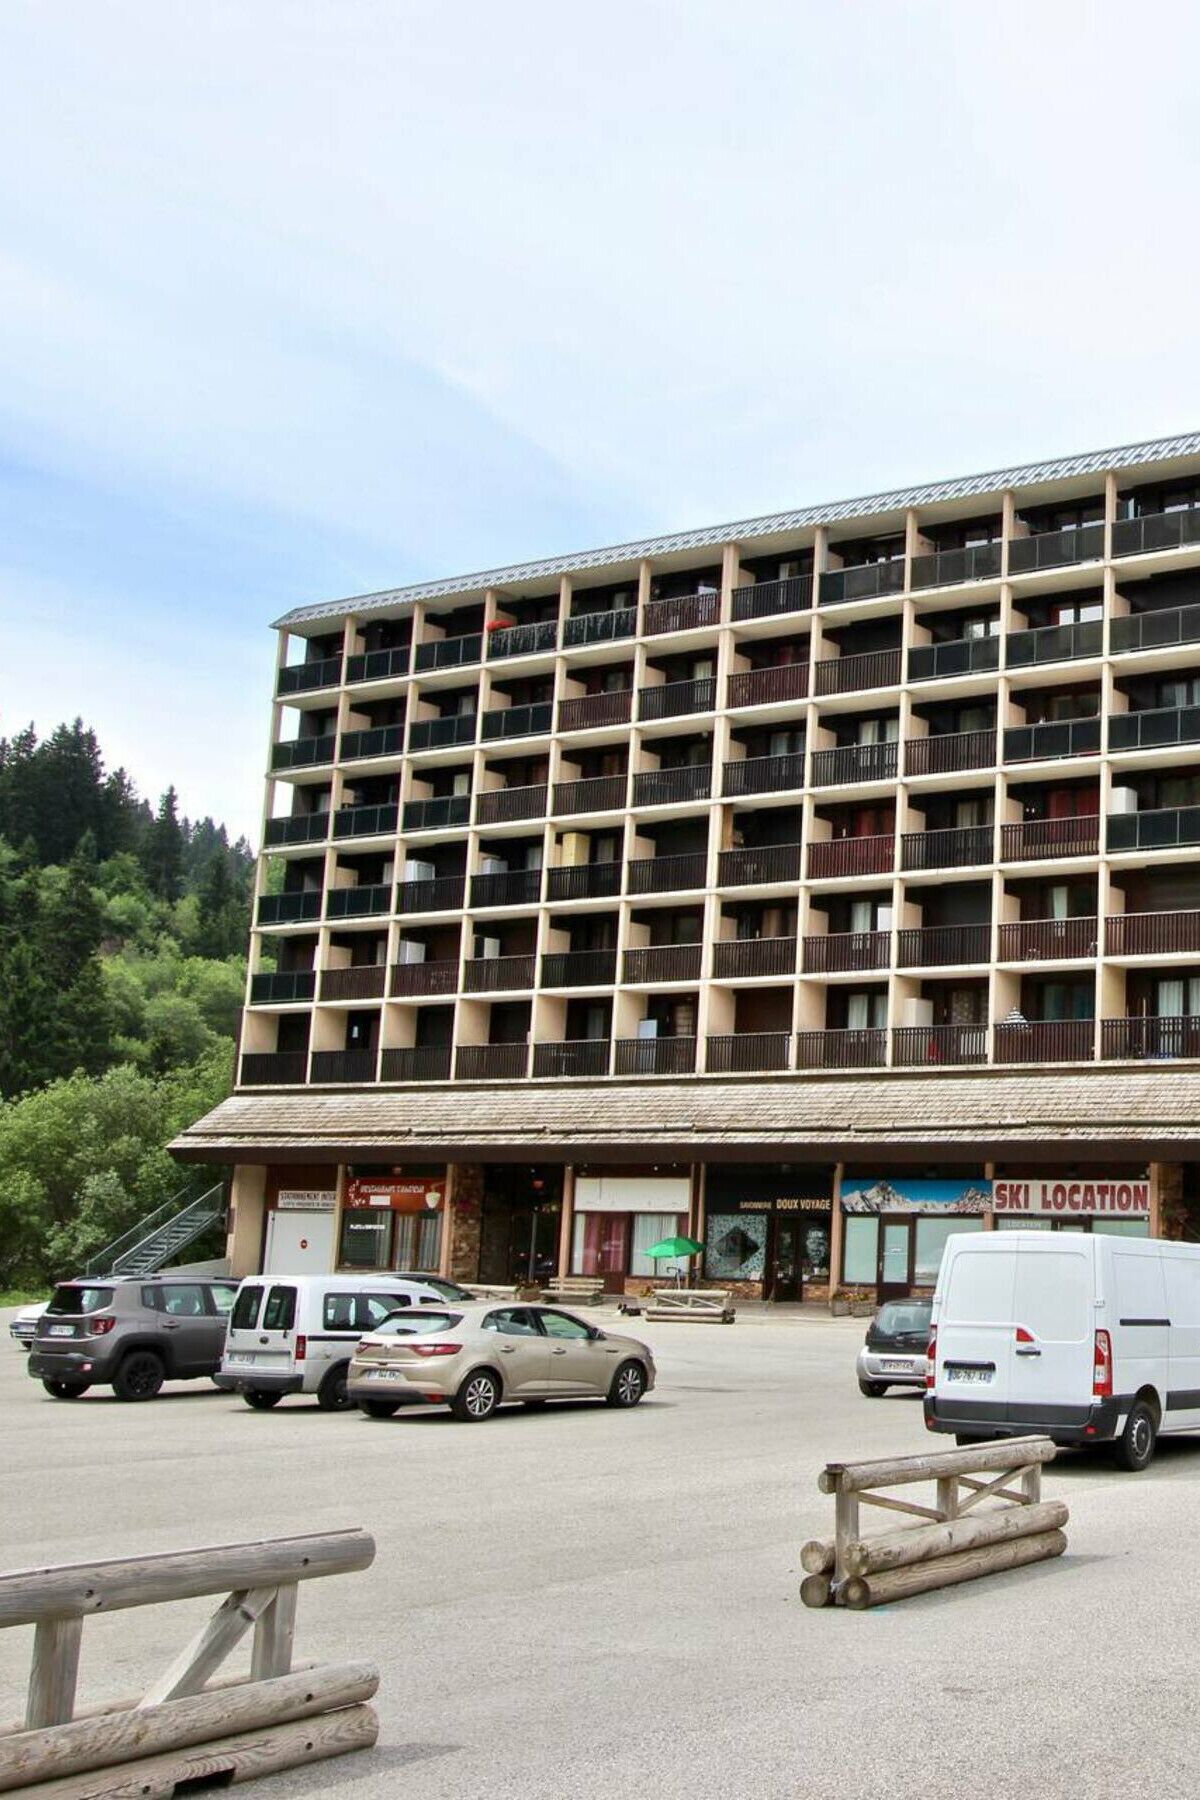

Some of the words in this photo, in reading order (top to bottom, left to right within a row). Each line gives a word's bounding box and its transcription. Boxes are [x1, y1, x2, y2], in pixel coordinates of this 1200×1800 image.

[776, 1199, 799, 1210] DOUX
[800, 1199, 831, 1210] VOYAGE
[995, 1183, 1030, 1209] SKI
[1041, 1183, 1148, 1211] LOCATION
